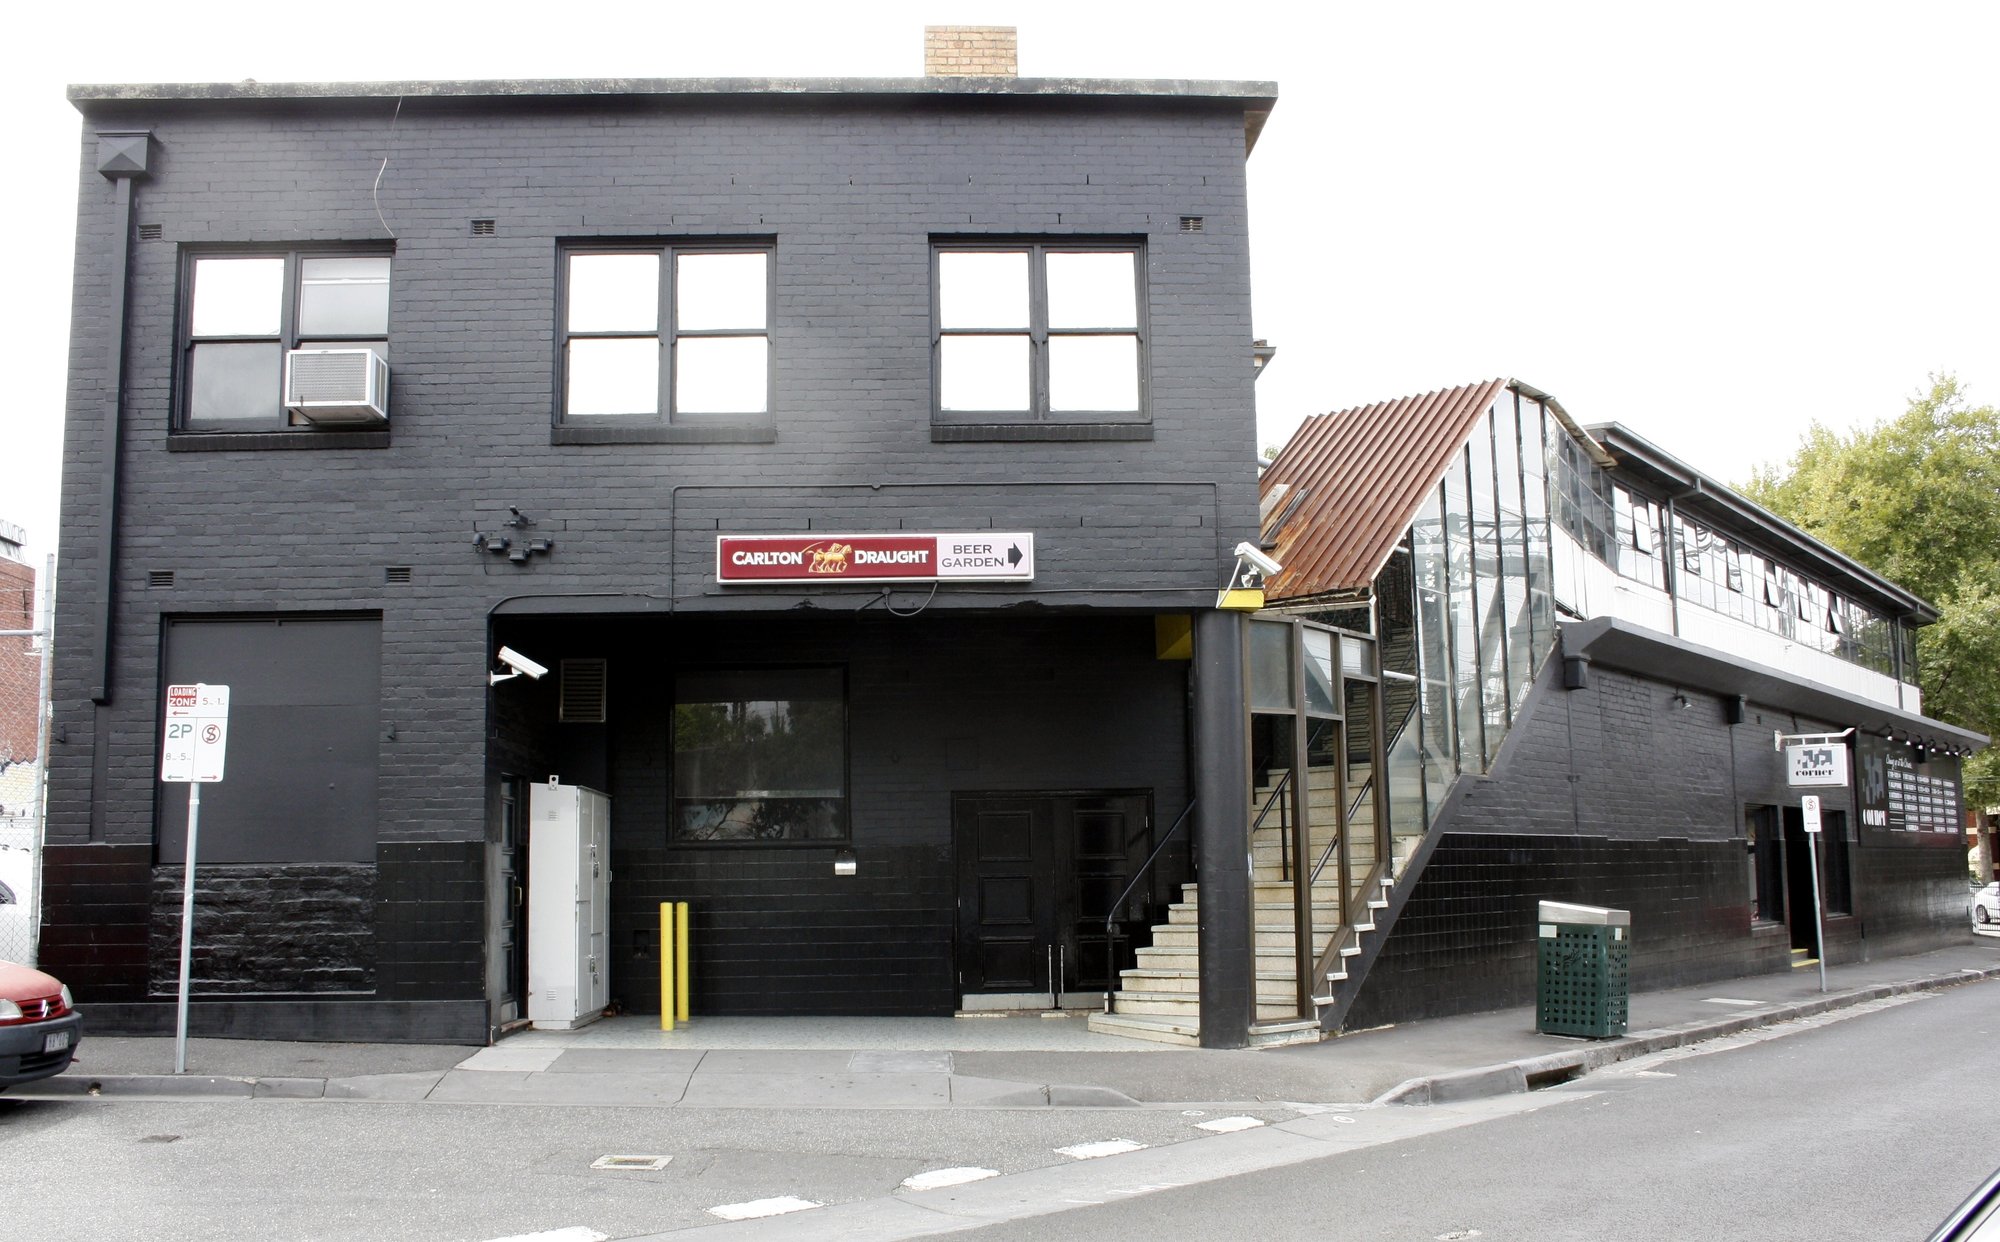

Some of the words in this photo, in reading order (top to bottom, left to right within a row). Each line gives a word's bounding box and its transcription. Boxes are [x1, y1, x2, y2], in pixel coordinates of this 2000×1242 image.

[953, 544, 993, 554] BEER
[732, 551, 803, 565] CARLTON
[854, 550, 929, 564] DRAUGHT
[941, 557, 1004, 567] GARDEN
[170, 687, 196, 697] LOADING
[169, 697, 197, 706] ZONE
[168, 723, 193, 739] 2P
[1795, 769, 1834, 777] corner
